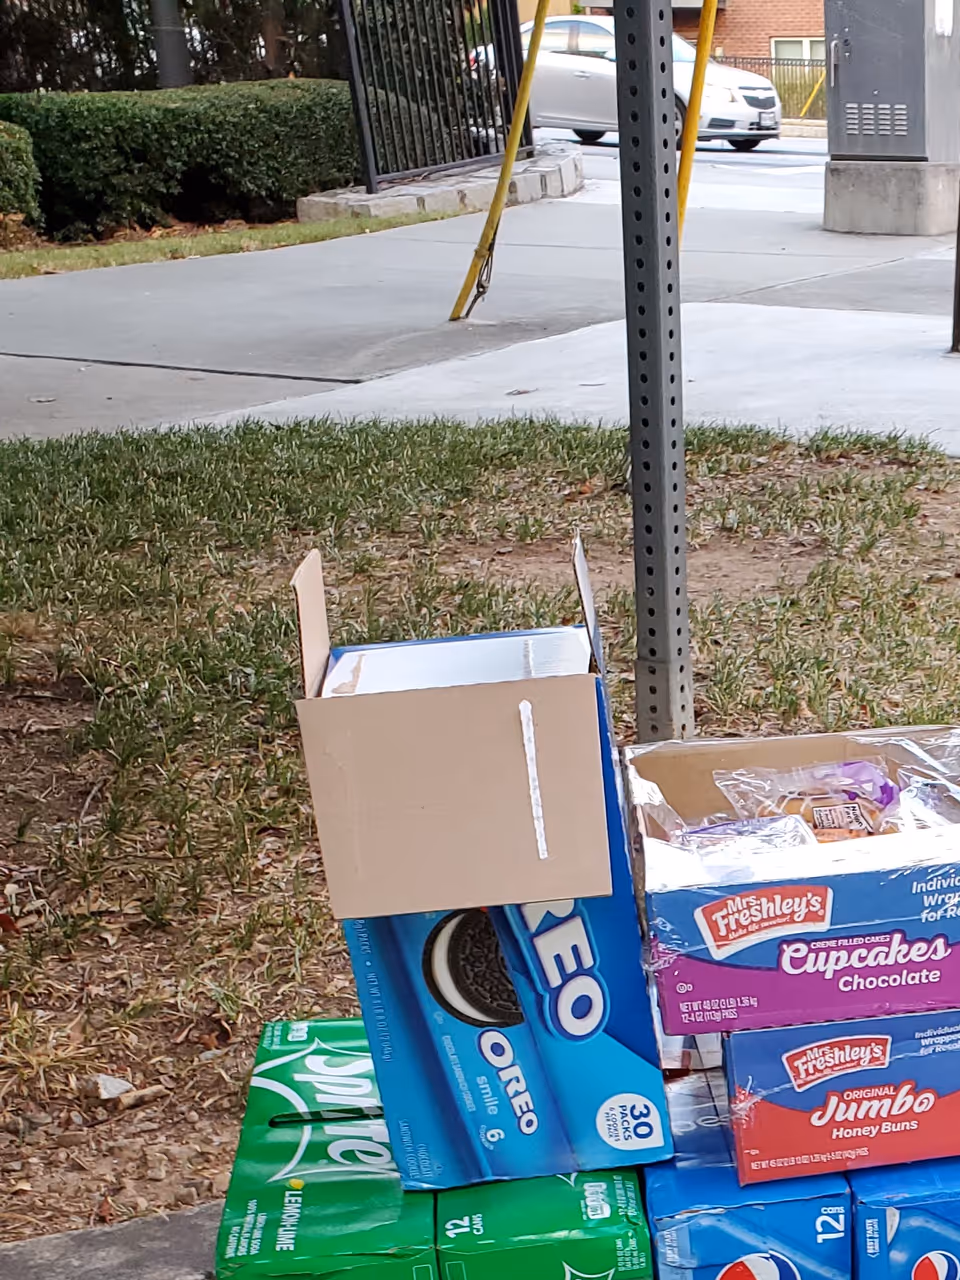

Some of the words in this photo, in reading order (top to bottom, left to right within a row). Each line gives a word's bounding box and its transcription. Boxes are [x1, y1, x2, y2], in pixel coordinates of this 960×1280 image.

[712, 892, 821, 936] Freshley's
[727, 896, 760, 913] Mrs.
[921, 908, 942, 922] for
[810, 940, 835, 949] CREME
[836, 937, 863, 947] FILLED
[864, 934, 890, 944] CAKES
[520, 899, 602, 1035] REO
[781, 934, 951, 979] Cupcakes
[838, 968, 941, 992] Chocolate
[794, 1042, 883, 1078] Freshley's
[807, 1046, 834, 1060] Mrs.
[481, 1030, 538, 1134] OREO
[844, 1086, 896, 1100] ORIGINAL
[476, 1075, 499, 1115] smile
[810, 1085, 935, 1126] Jumbo
[611, 1114, 621, 1141] COOKIES
[619, 1105, 632, 1140] PACKS
[630, 1103, 654, 1140] 30
[832, 1122, 880, 1140] Honey
[881, 1118, 918, 1134] Buns
[487, 1129, 505, 1142] 6
[821, 1205, 845, 1215] cans
[445, 1214, 471, 1238] 12
[472, 1213, 483, 1236] CANS
[815, 1215, 845, 1243] 12
